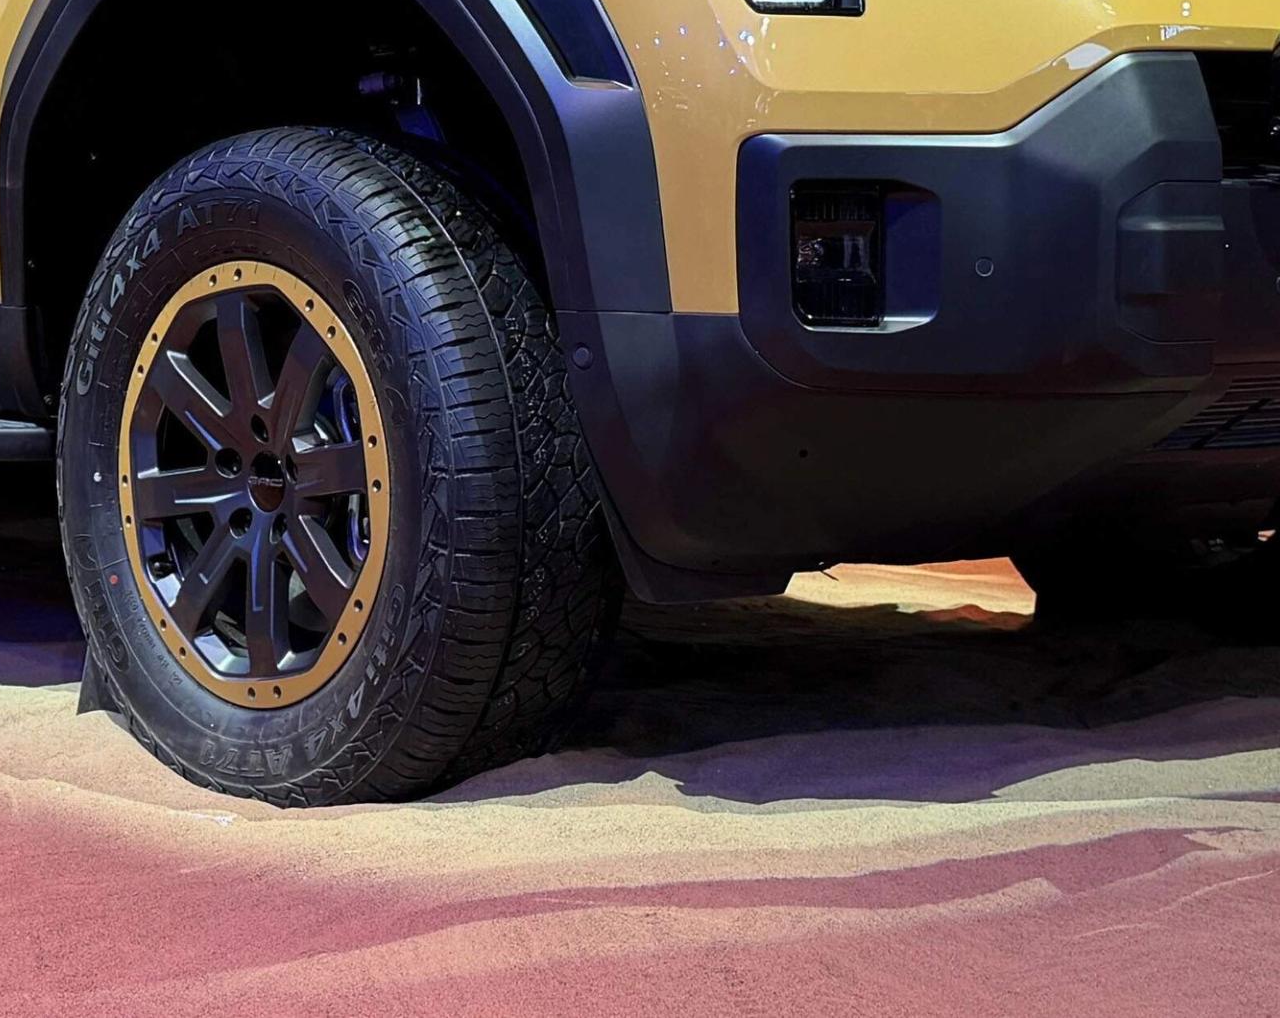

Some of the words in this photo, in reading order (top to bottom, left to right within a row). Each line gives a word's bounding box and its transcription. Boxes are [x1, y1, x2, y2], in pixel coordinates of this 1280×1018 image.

[76, 306, 113, 396] Giti
[176, 198, 261, 236] AT71
[200, 741, 293, 777] AT71
